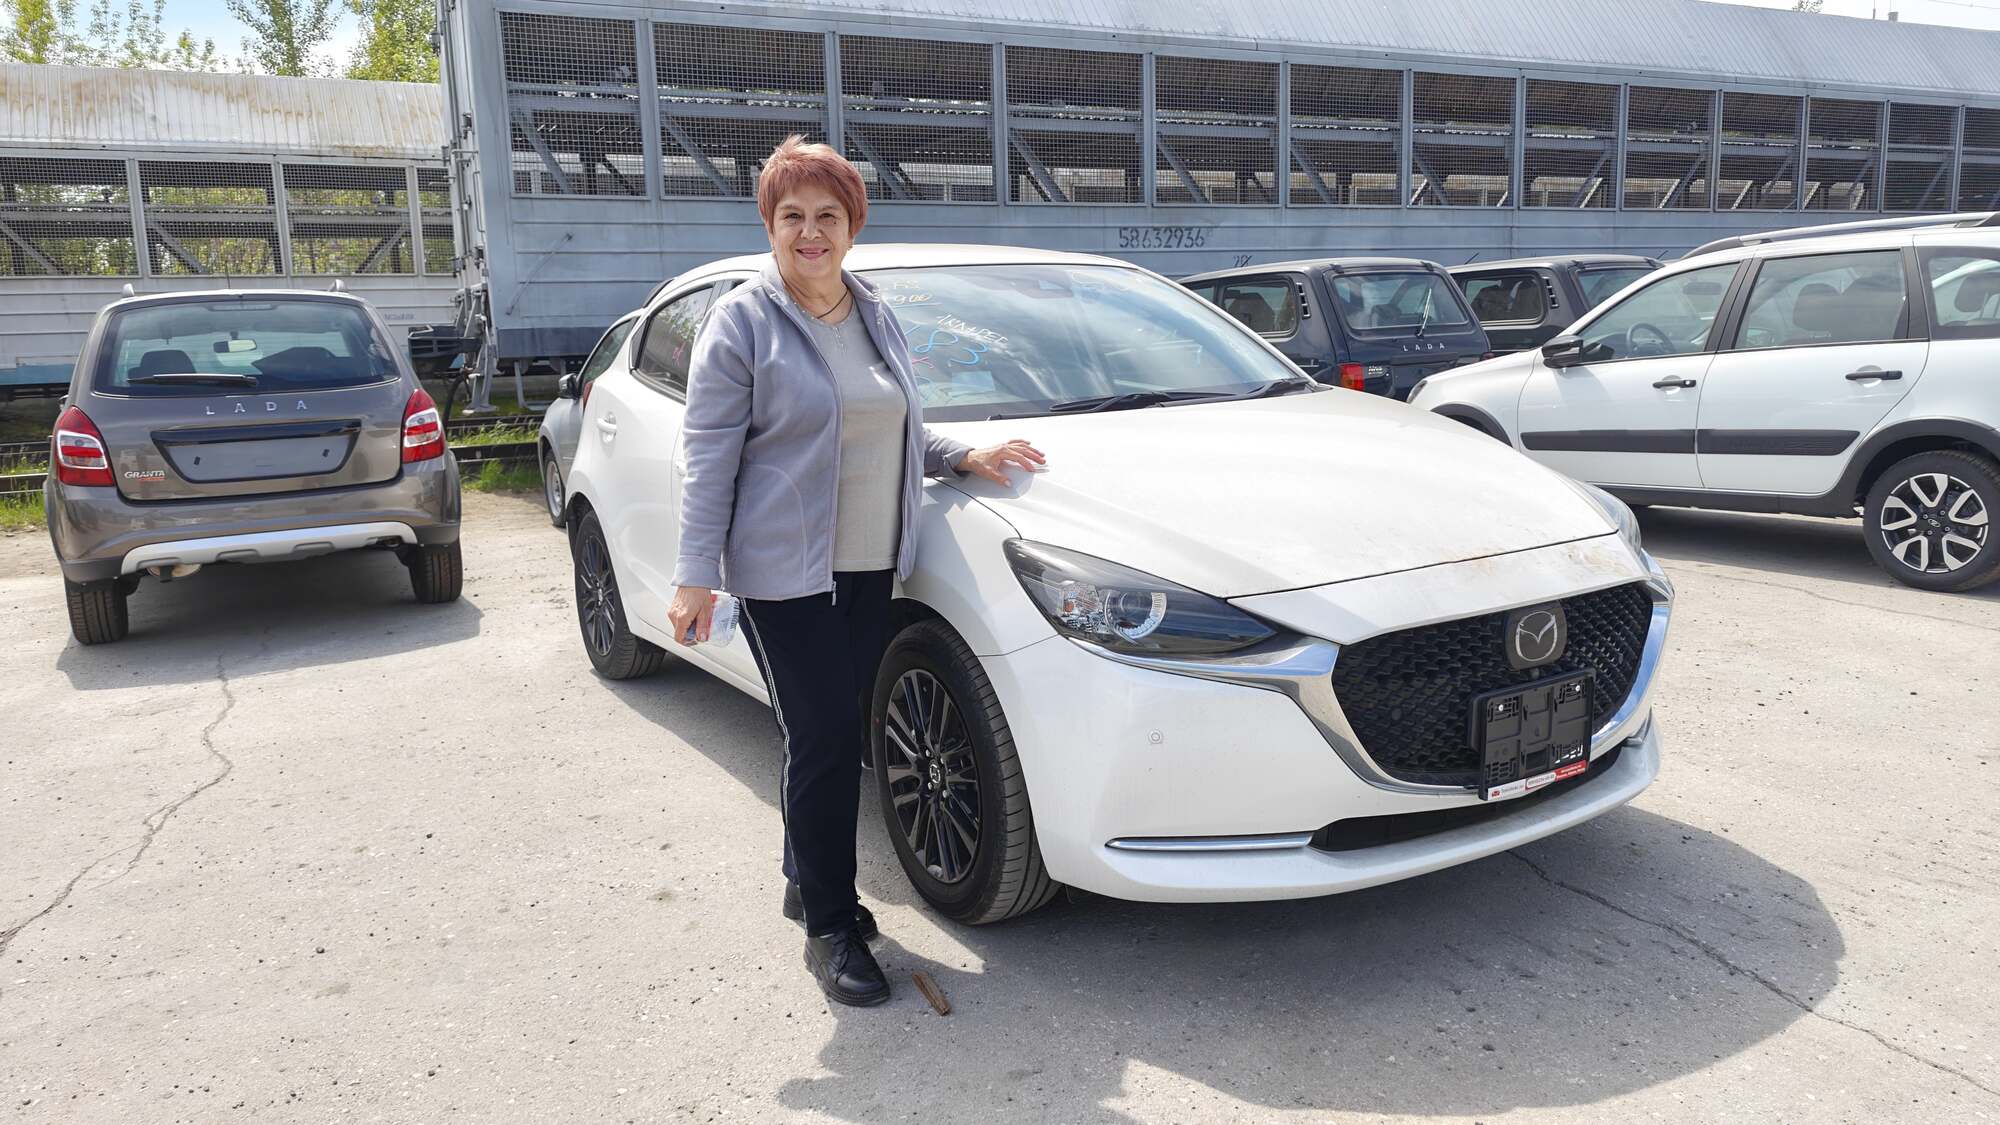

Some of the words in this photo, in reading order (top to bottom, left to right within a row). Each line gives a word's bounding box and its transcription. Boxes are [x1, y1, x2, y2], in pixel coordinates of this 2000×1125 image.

[1119, 228, 1205, 248] 58632936
[1403, 342, 1446, 352] LADA
[206, 400, 307, 415] LADA
